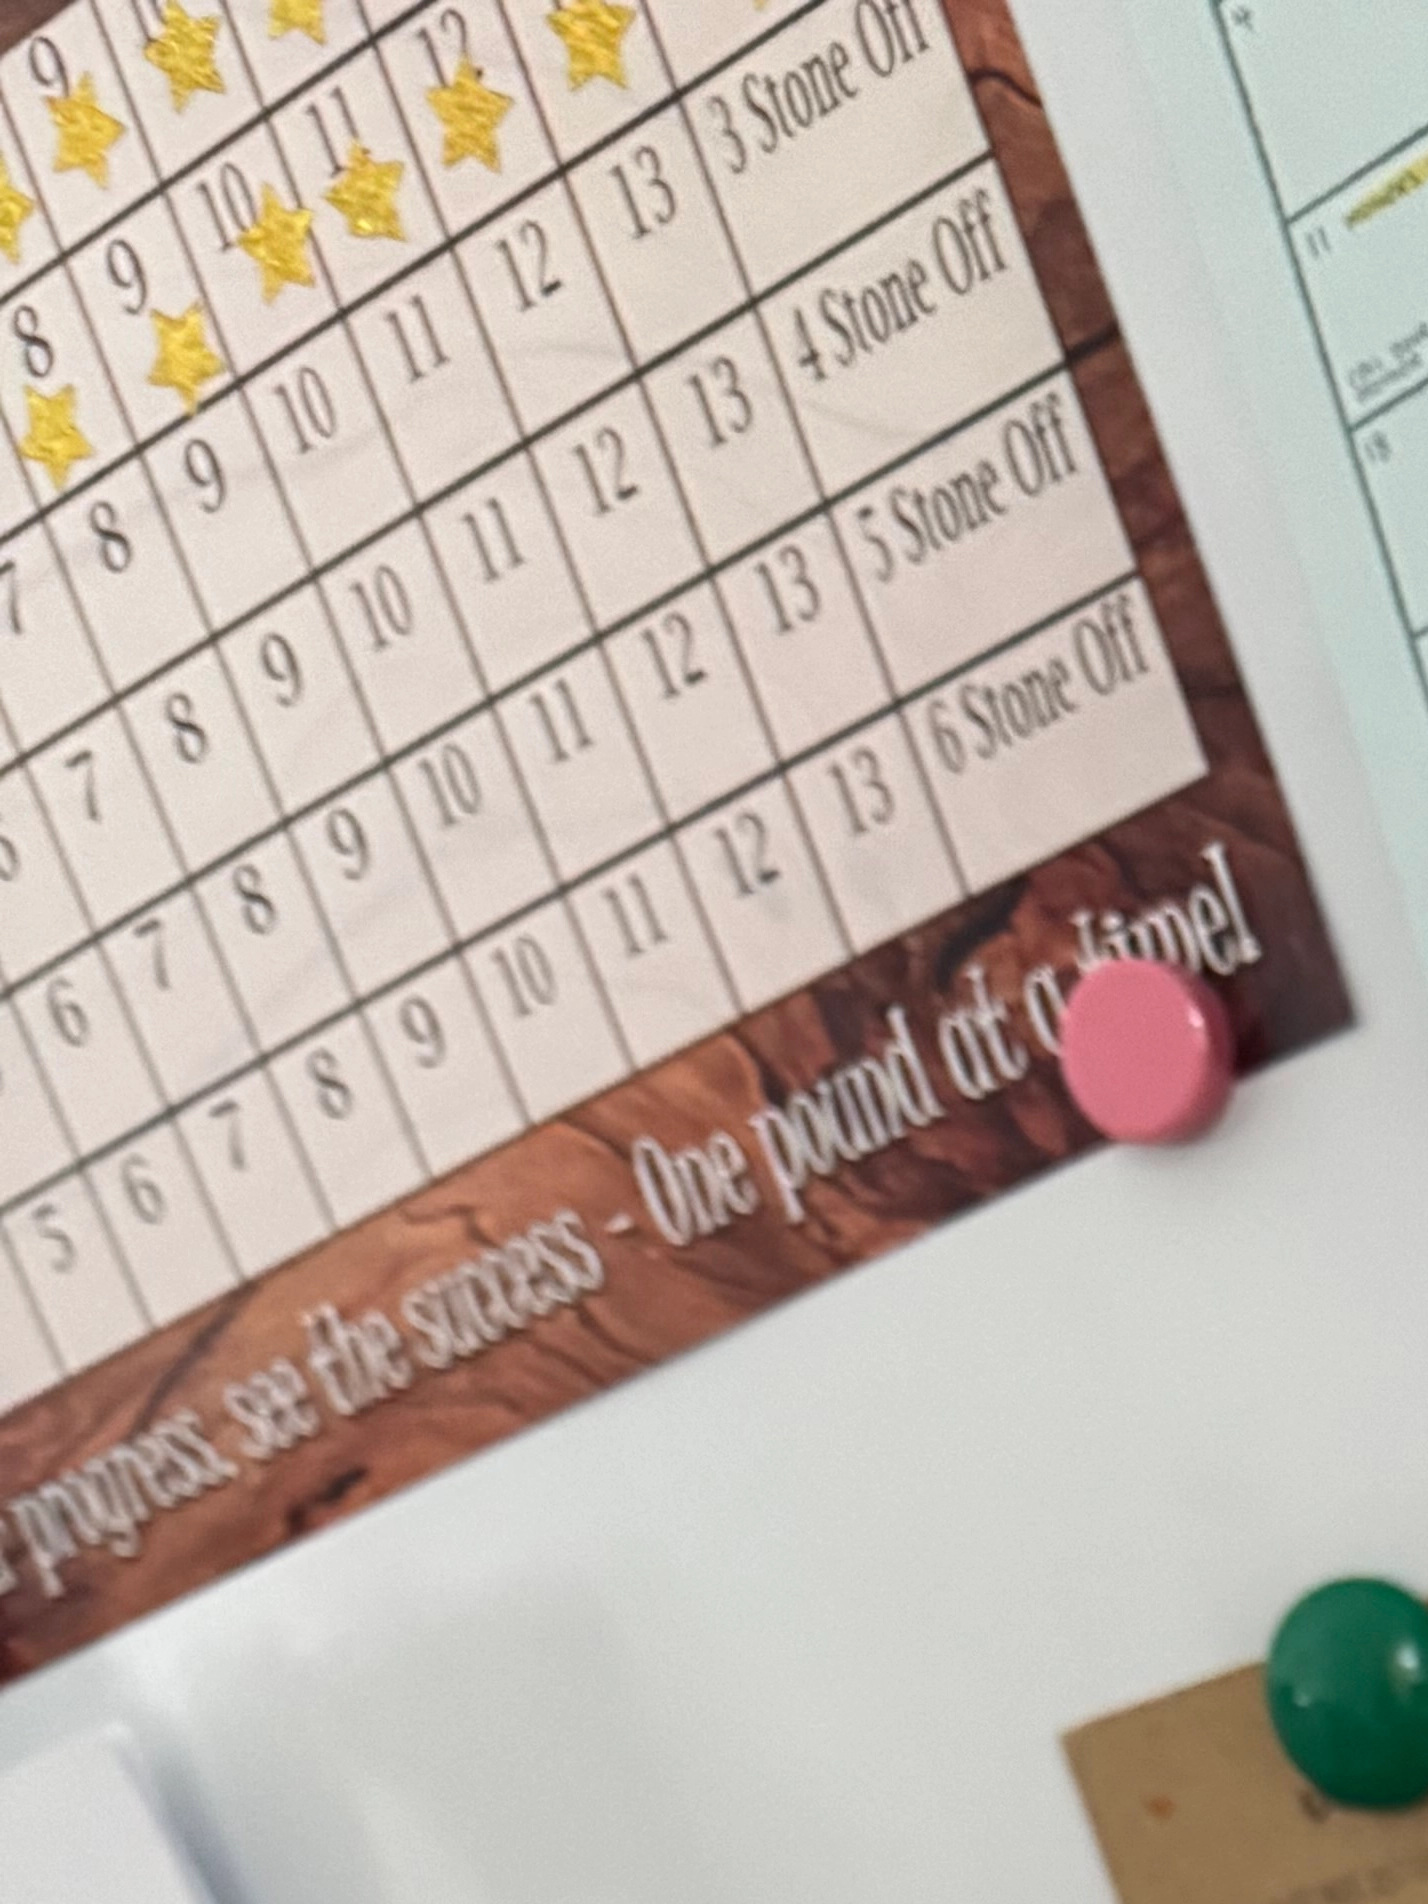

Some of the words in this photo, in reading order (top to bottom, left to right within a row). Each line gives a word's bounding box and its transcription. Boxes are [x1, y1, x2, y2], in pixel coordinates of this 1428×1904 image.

[10, 305, 55, 378] 8
[105, 238, 148, 317] 9
[196, 161, 259, 253] 10
[64, 749, 102, 822] 7
[165, 693, 209, 765] 8
[260, 632, 305, 708] 9
[350, 564, 414, 653] 10
[461, 497, 525, 582] 11
[571, 426, 639, 518] 12
[686, 356, 754, 450] 13
[794, 307, 828, 384] 4
[821, 256, 938, 371] Stone
[931, 187, 1009, 297] Off
[89, 500, 132, 574] 8
[183, 438, 227, 514] 9
[274, 365, 338, 455] 10
[385, 295, 451, 384] 11
[496, 219, 563, 312] 12
[610, 144, 679, 241] 13
[708, 93, 748, 175] 3
[741, 41, 858, 155] Stone
[853, 0, 931, 79] Off
[1304, 225, 1332, 261] 11
[31, 1203, 76, 1273] 5
[119, 1154, 165, 1227] 6
[209, 1101, 248, 1172] 7
[306, 1046, 352, 1120] 8
[400, 994, 447, 1070] 9
[492, 932, 557, 1019] 10
[603, 872, 669, 959] 11
[714, 810, 780, 899] 12
[826, 744, 896, 838] 13
[927, 703, 965, 777] 6
[959, 654, 1080, 761] Stone
[1072, 591, 1152, 697] Off
[45, 976, 90, 1049] 6
[132, 917, 171, 992] 7
[232, 863, 278, 936] 8
[325, 807, 371, 882] 9
[418, 742, 483, 829] 10
[530, 677, 593, 764] 11
[640, 612, 709, 701] 12
[753, 543, 824, 634] 13
[856, 506, 896, 585] 5
[890, 457, 1009, 566] Stone
[1004, 389, 1079, 499] Off
[223, 1357, 320, 1461] see
[301, 1302, 411, 1417] the
[399, 1209, 603, 1371] success
[631, 1132, 757, 1247] One
[751, 1006, 945, 1222] pound
[937, 966, 1028, 1100] at
